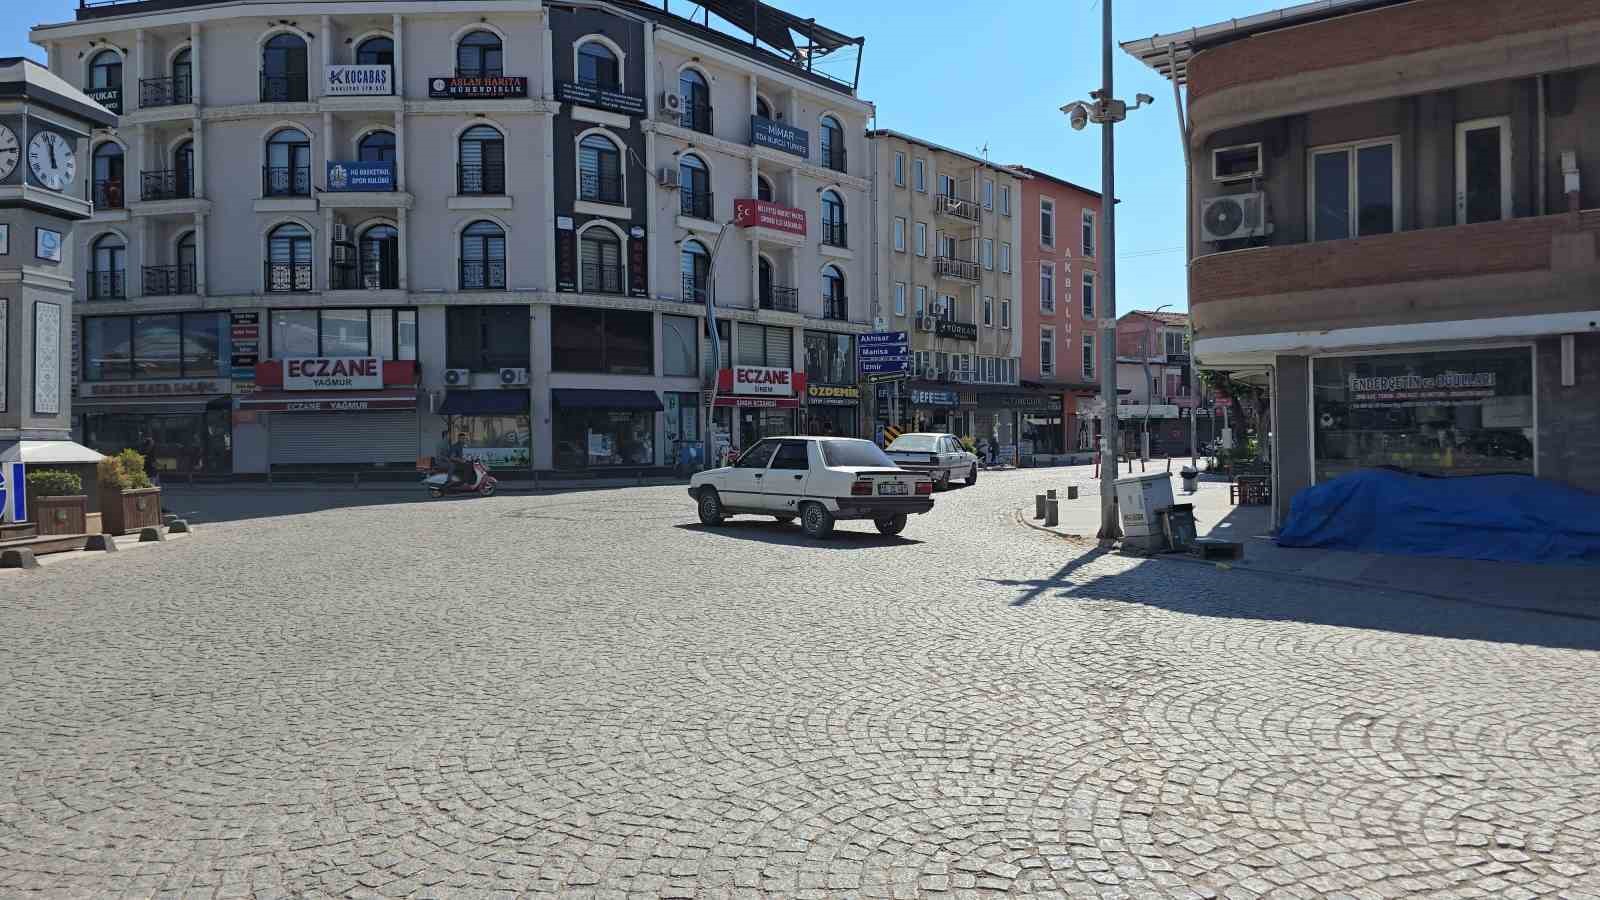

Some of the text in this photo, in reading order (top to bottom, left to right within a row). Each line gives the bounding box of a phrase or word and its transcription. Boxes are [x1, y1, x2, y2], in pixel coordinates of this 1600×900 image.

[1064, 248, 1072, 350] AKBULUT
[861, 335, 889, 343] Akhisar
[863, 347, 889, 355] Manisa
[288, 359, 378, 377] ECZANE
[737, 368, 790, 385] ECZANE
